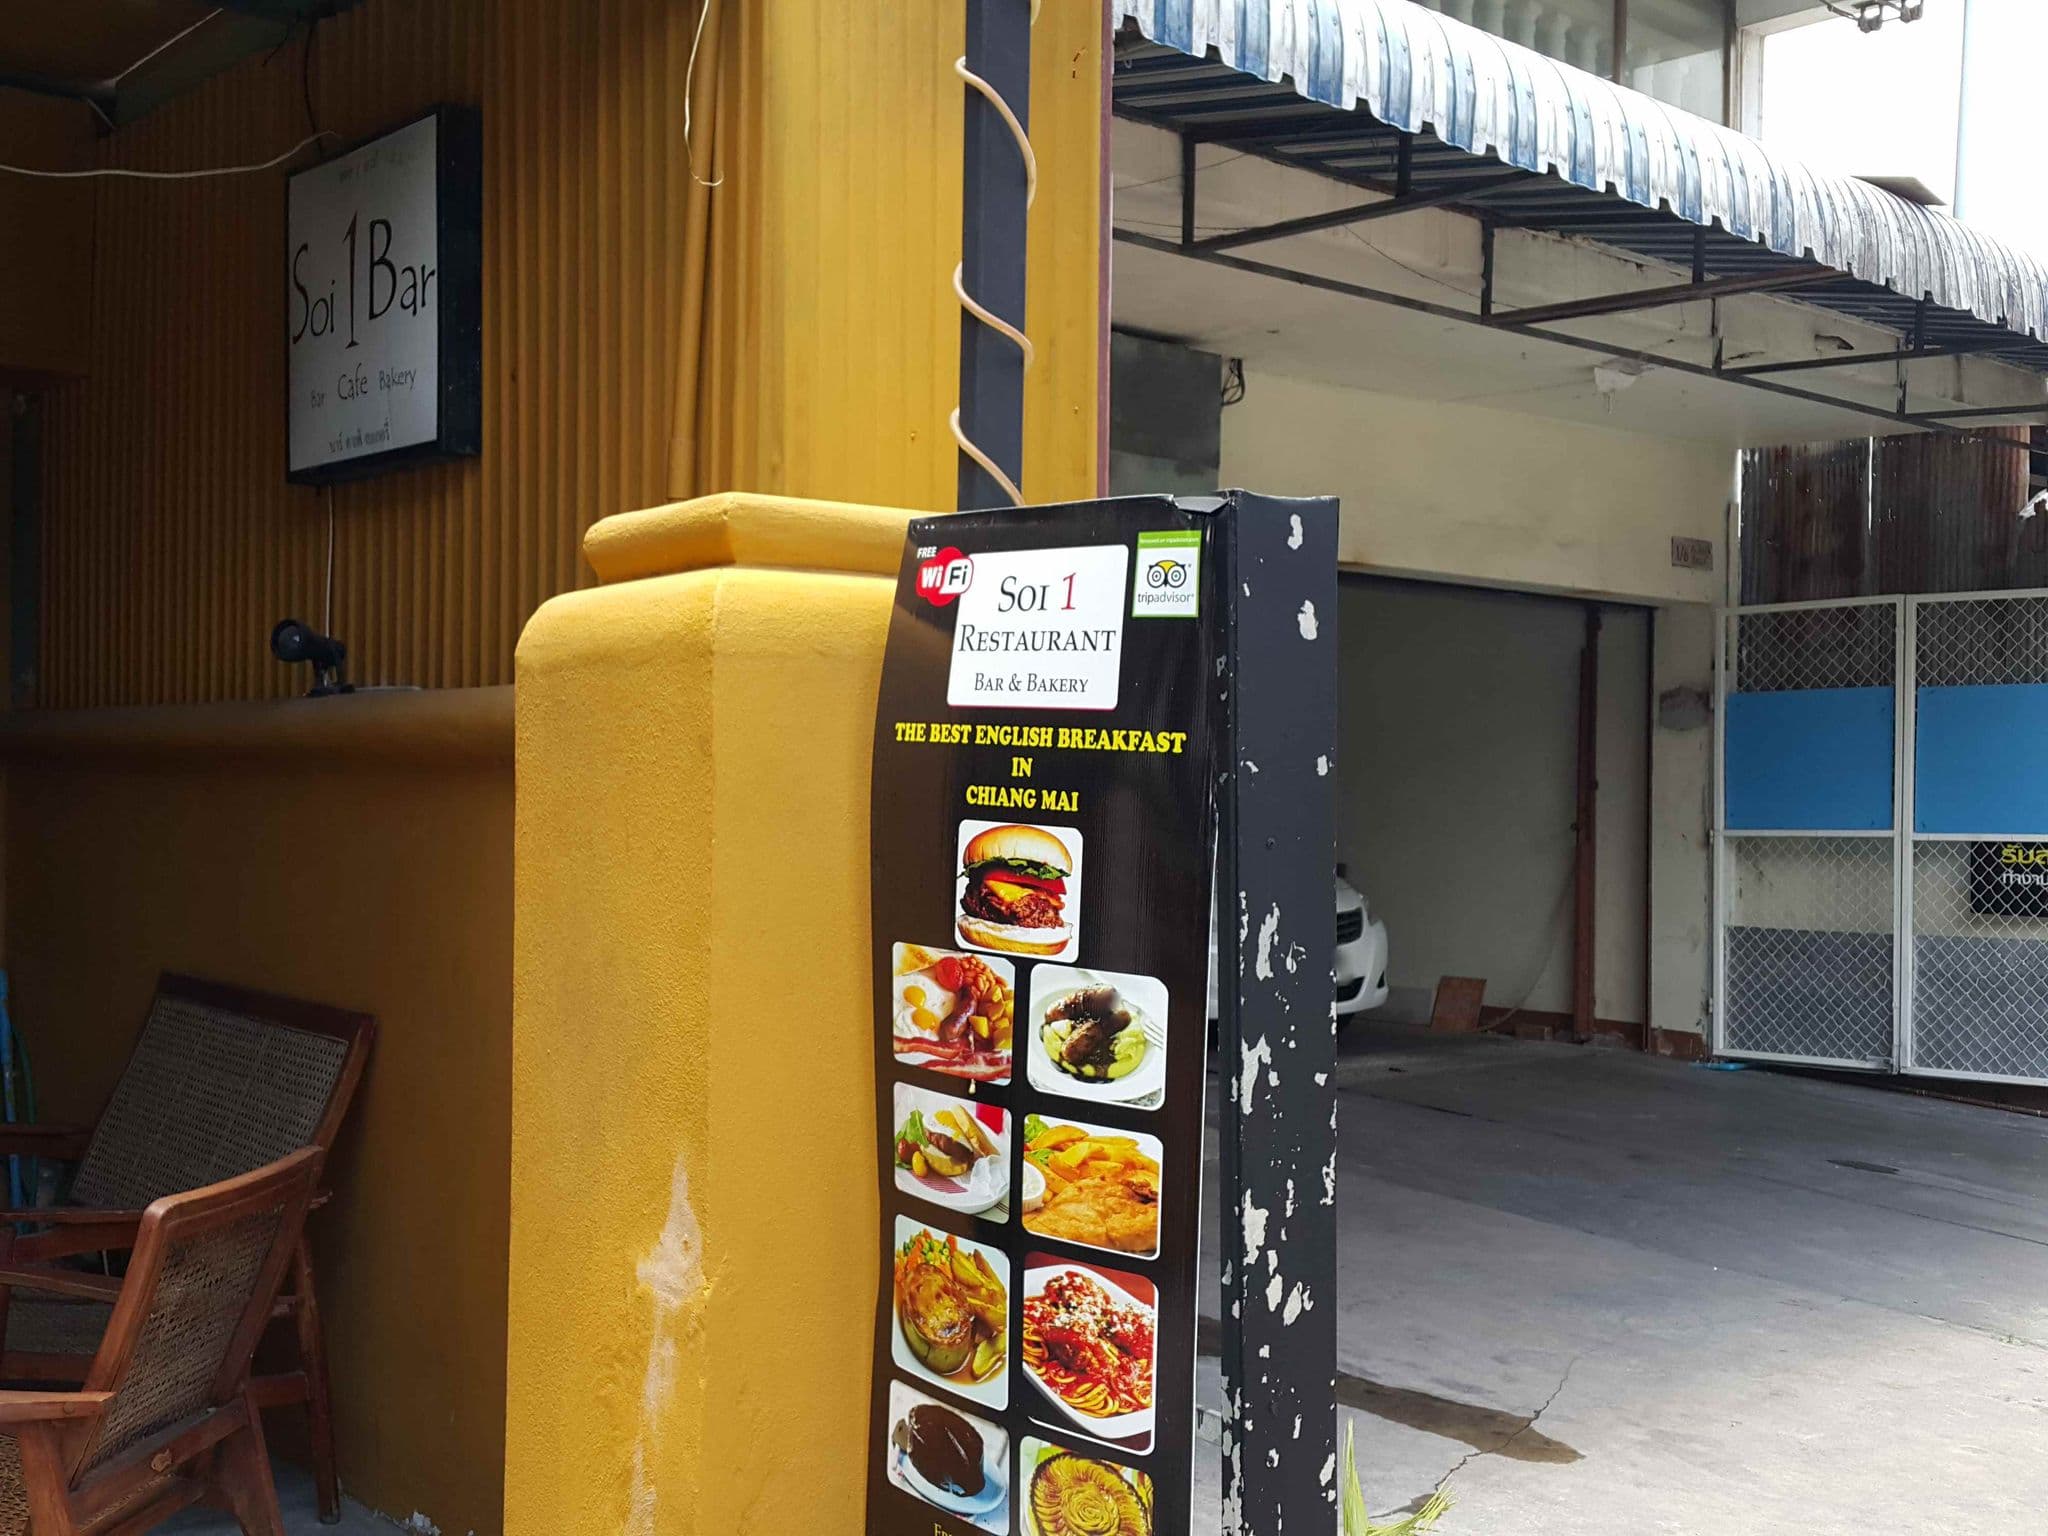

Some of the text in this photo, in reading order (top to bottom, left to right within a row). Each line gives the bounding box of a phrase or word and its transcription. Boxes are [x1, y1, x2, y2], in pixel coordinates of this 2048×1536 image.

[292, 208, 436, 350] Soi 1 Bar
[337, 362, 368, 400] Cafe
[378, 367, 416, 391] Bakery
[916, 546, 938, 559] FREE
[1060, 572, 1077, 611] 1
[1138, 590, 1192, 606] tripadvisor
[958, 624, 1117, 653] RESTAURANT
[1008, 674, 1022, 692] &
[1027, 673, 1089, 693] BAKERY
[895, 722, 1187, 754] THE BEST ENGLISH BREAKFAST
[1011, 756, 1033, 777] IN
[966, 785, 1079, 812] CHIANG MAI
